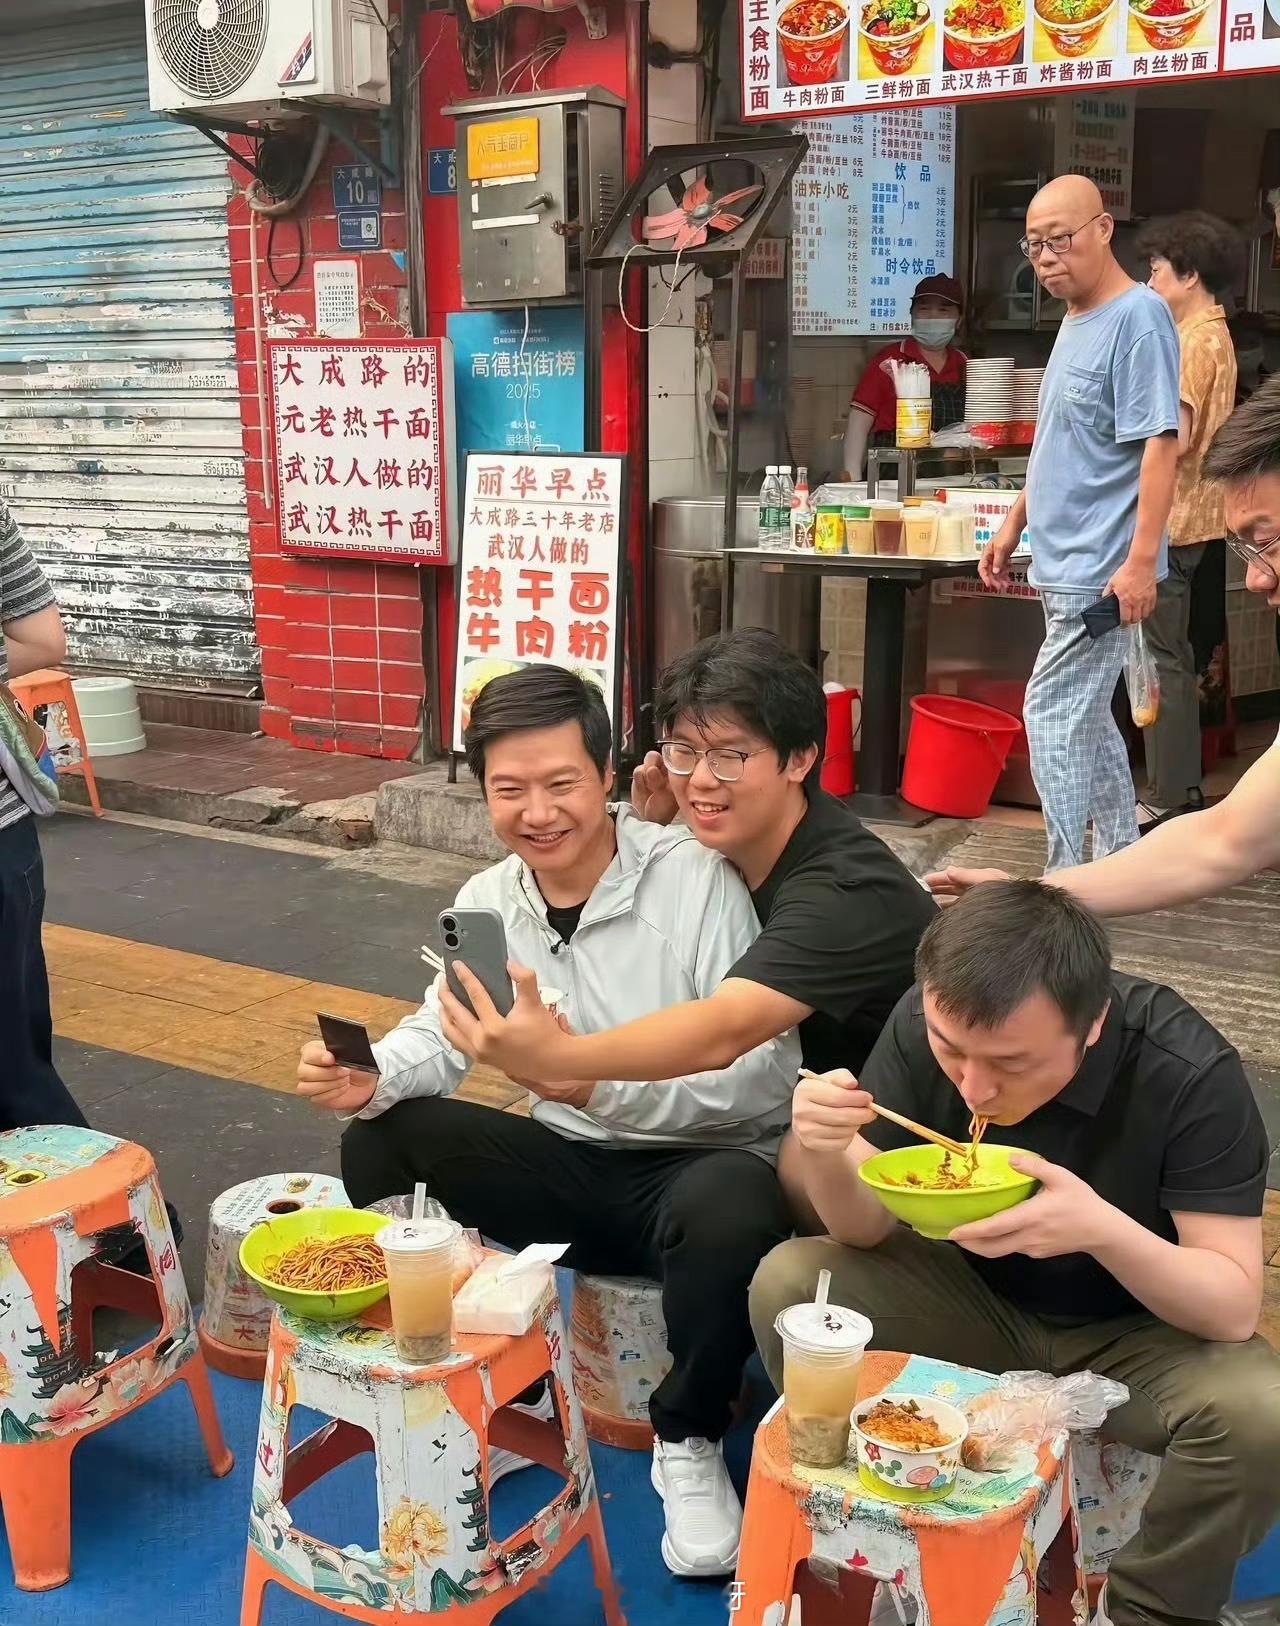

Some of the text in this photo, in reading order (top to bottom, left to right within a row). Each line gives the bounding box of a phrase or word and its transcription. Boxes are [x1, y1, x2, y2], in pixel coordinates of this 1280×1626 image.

[1040, 60, 1113, 83] 炸酱粉面
[1133, 52, 1209, 76] 肉丝粉面
[865, 79, 931, 100] 三鲜粉面
[941, 67, 1029, 91] 武汉热干面
[783, 86, 845, 108] 牛肉粉面
[895, 162, 931, 182] 饮品
[796, 179, 849, 199] 油炸小吃
[886, 257, 936, 275] 时令饮品
[279, 354, 430, 388] 大成路的
[470, 351, 576, 378] 高德扫街榜
[281, 405, 431, 439] 元老热干面
[284, 452, 433, 491] 武汉人做的
[477, 465, 610, 502] 丽华早点
[287, 501, 433, 541] 武汉热干面
[469, 506, 615, 535] 大成路三十年老店
[488, 533, 589, 566] 武汉人做的
[466, 565, 610, 615] 热干面
[466, 612, 610, 662] 牛肉粉
